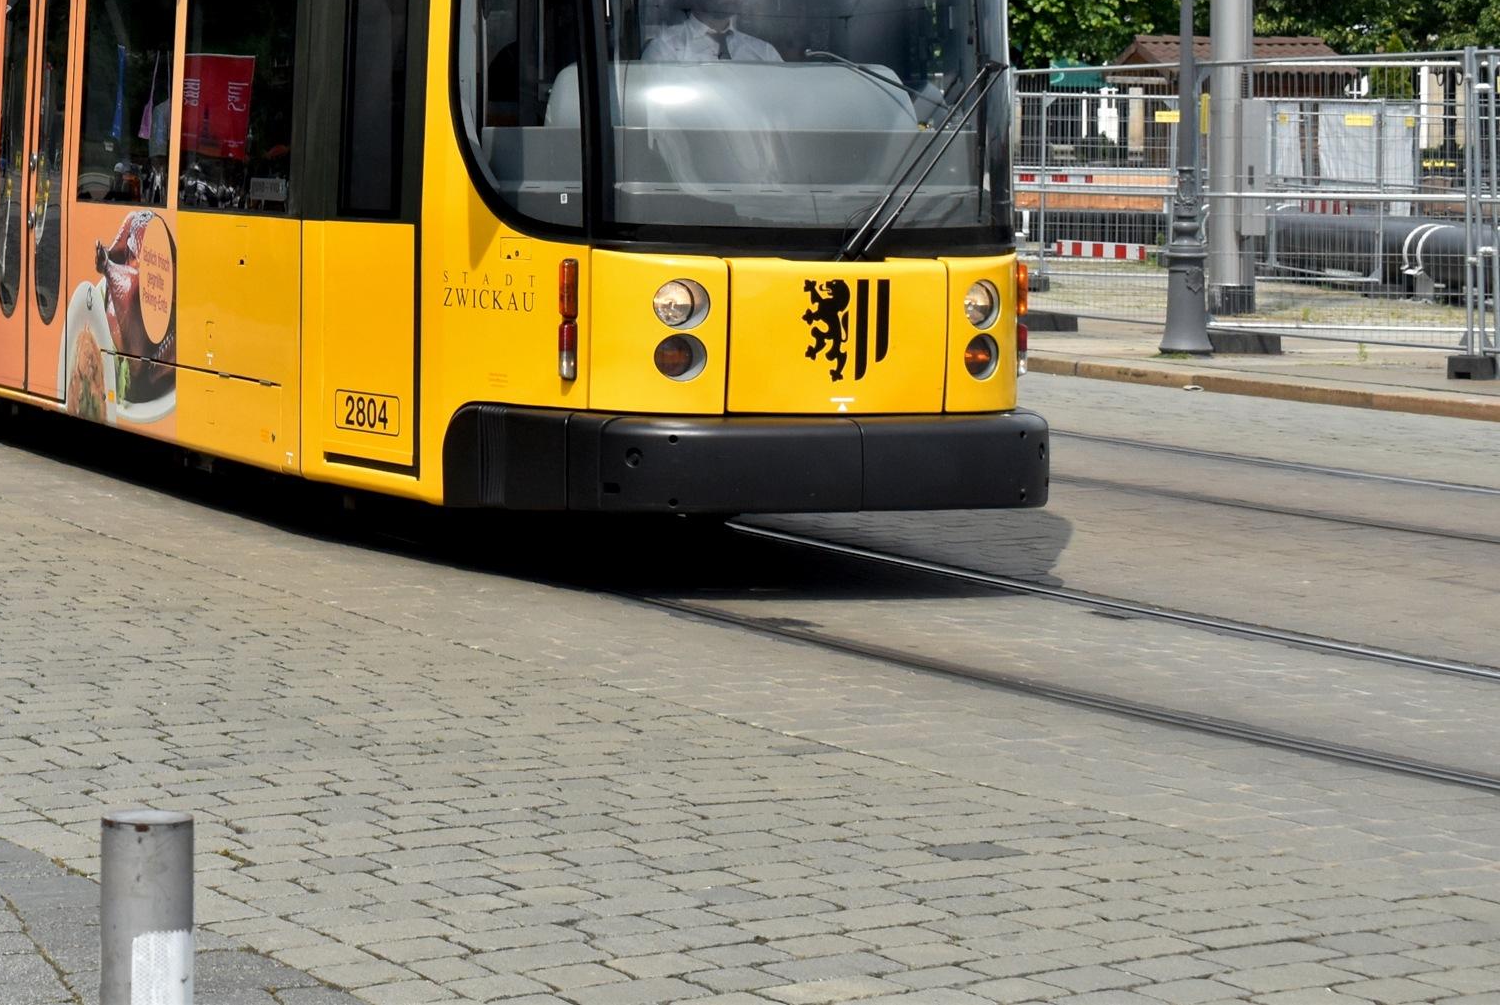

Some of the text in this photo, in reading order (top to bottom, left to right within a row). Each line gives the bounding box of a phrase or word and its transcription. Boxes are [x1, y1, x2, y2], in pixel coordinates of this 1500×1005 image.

[443, 270, 536, 287] STADT
[443, 287, 536, 312] ZWICKAU
[345, 395, 389, 430] 2804
